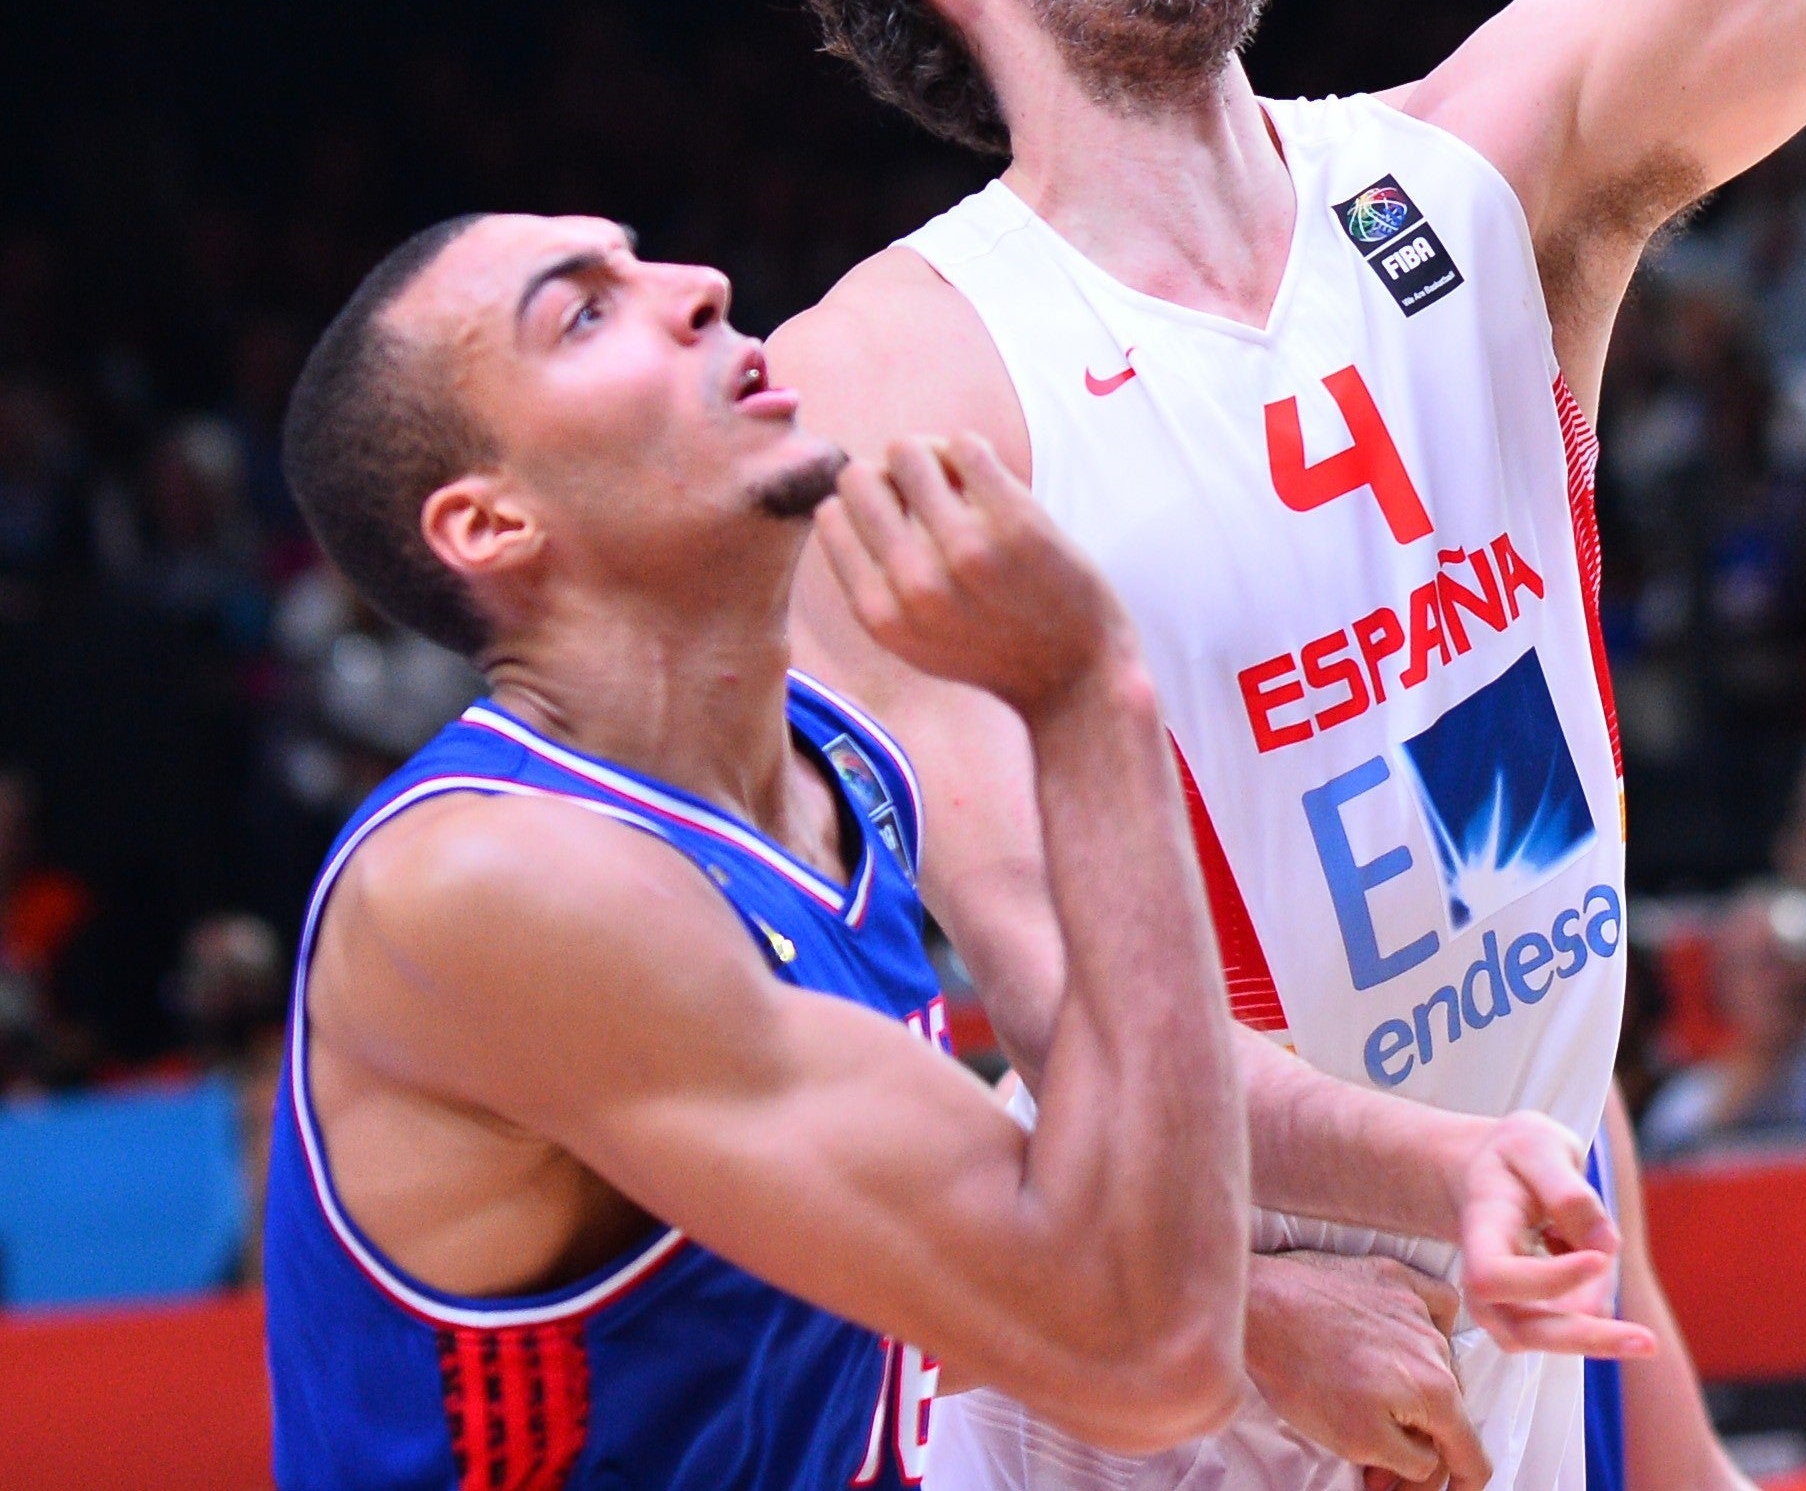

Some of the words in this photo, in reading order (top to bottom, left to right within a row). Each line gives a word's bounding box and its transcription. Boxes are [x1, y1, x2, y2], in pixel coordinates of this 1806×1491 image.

[1381, 236, 1436, 280] FIBA
[1264, 364, 1435, 544] 4
[1237, 532, 1545, 754] ESPAÑA
[1363, 884, 1622, 1088] endesa
